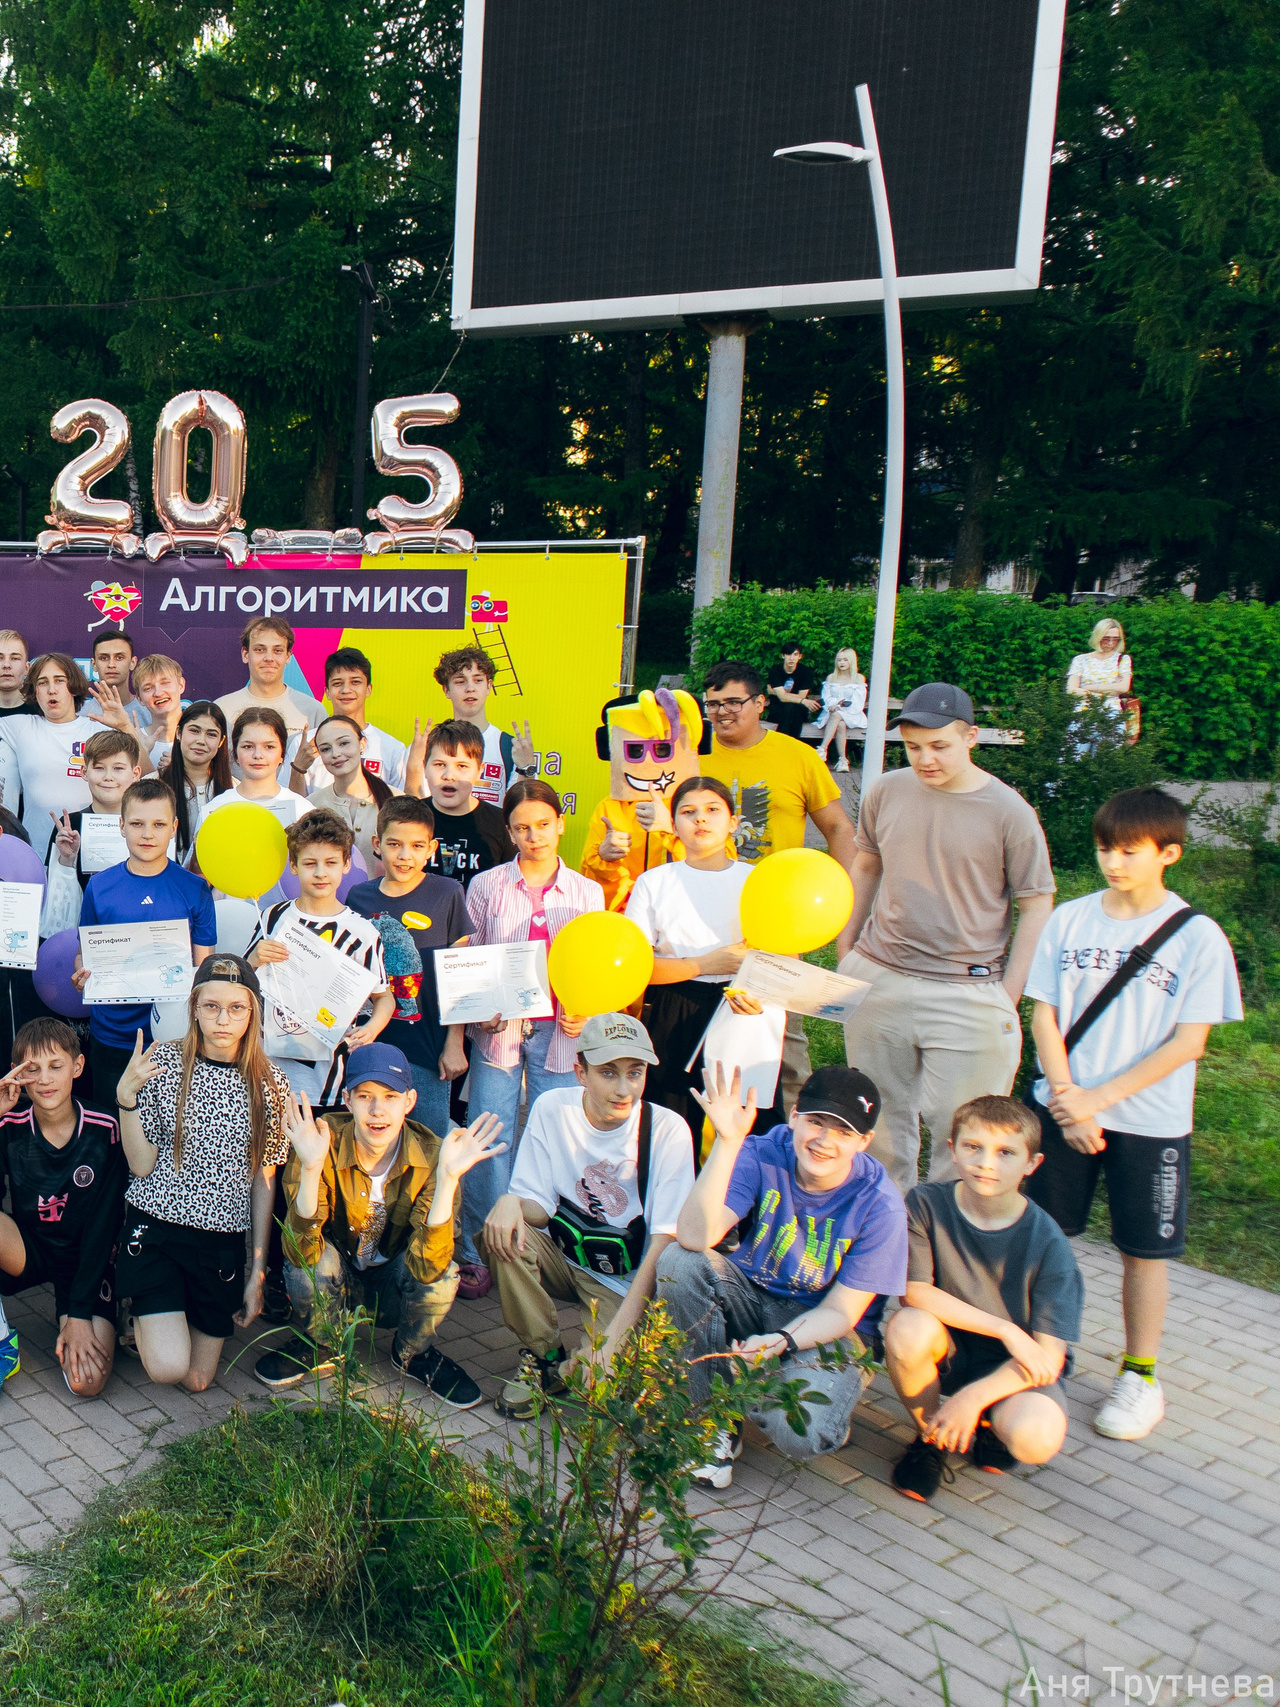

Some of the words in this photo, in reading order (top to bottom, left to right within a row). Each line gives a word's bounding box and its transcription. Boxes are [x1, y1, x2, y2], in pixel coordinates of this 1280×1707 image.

[159, 577, 450, 618] Алгоритмика
[88, 937, 132, 946] Сертификат
[284, 932, 321, 960] Сертификат
[443, 960, 487, 970] Сертификат
[754, 954, 802, 979] Сертификат
[604, 1026, 639, 1038] EXPLORER
